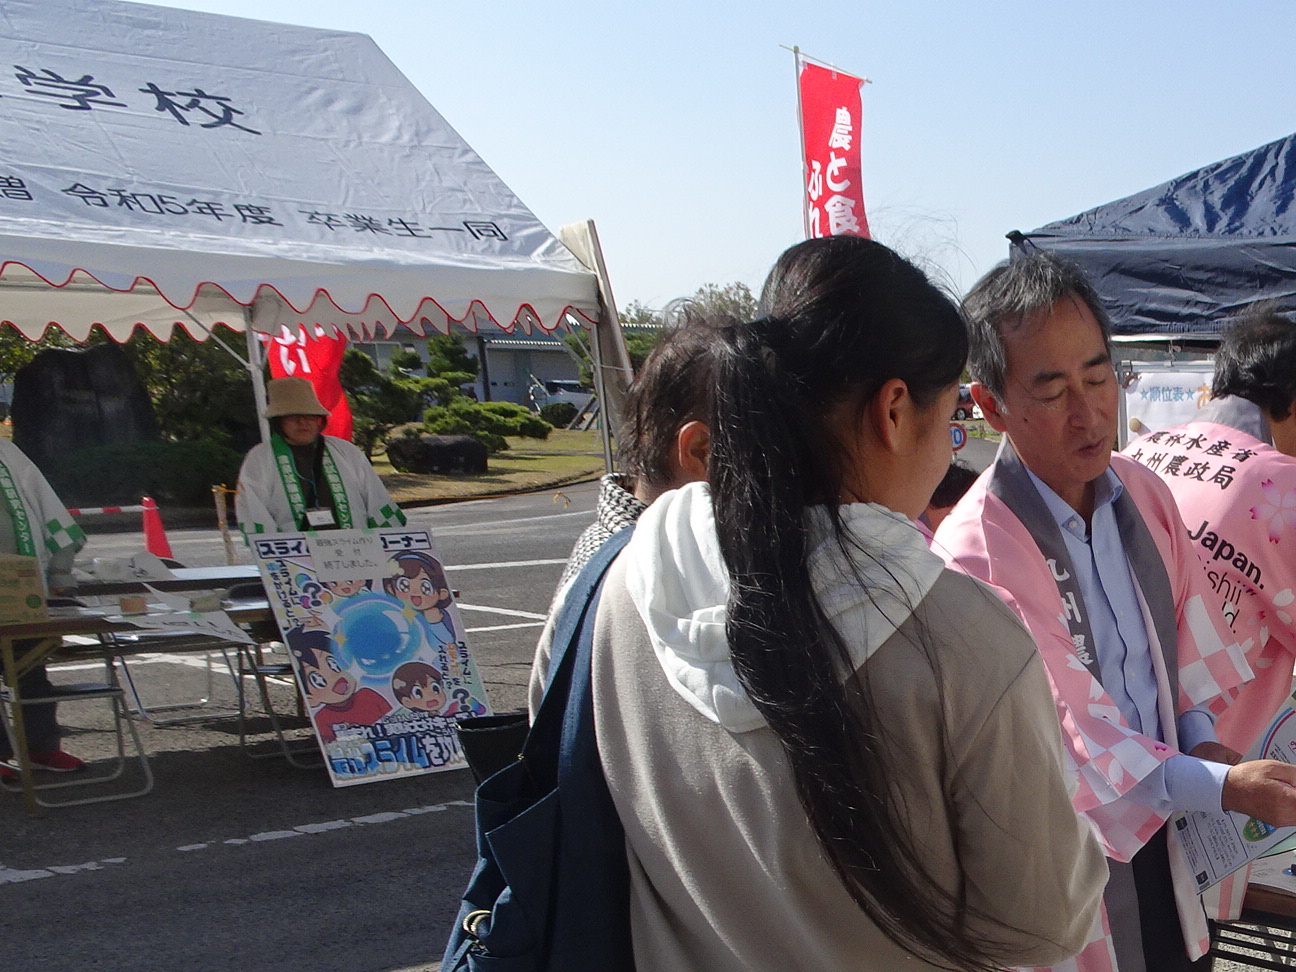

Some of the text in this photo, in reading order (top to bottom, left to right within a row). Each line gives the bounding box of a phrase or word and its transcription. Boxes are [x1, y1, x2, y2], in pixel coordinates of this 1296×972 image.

[15, 64, 262, 136] 学校
[61, 183, 283, 226] 令和5年度
[300, 208, 509, 242] 卒業生一同
[1143, 431, 1258, 462] 農林水産省
[1187, 521, 1265, 589] Japan.
